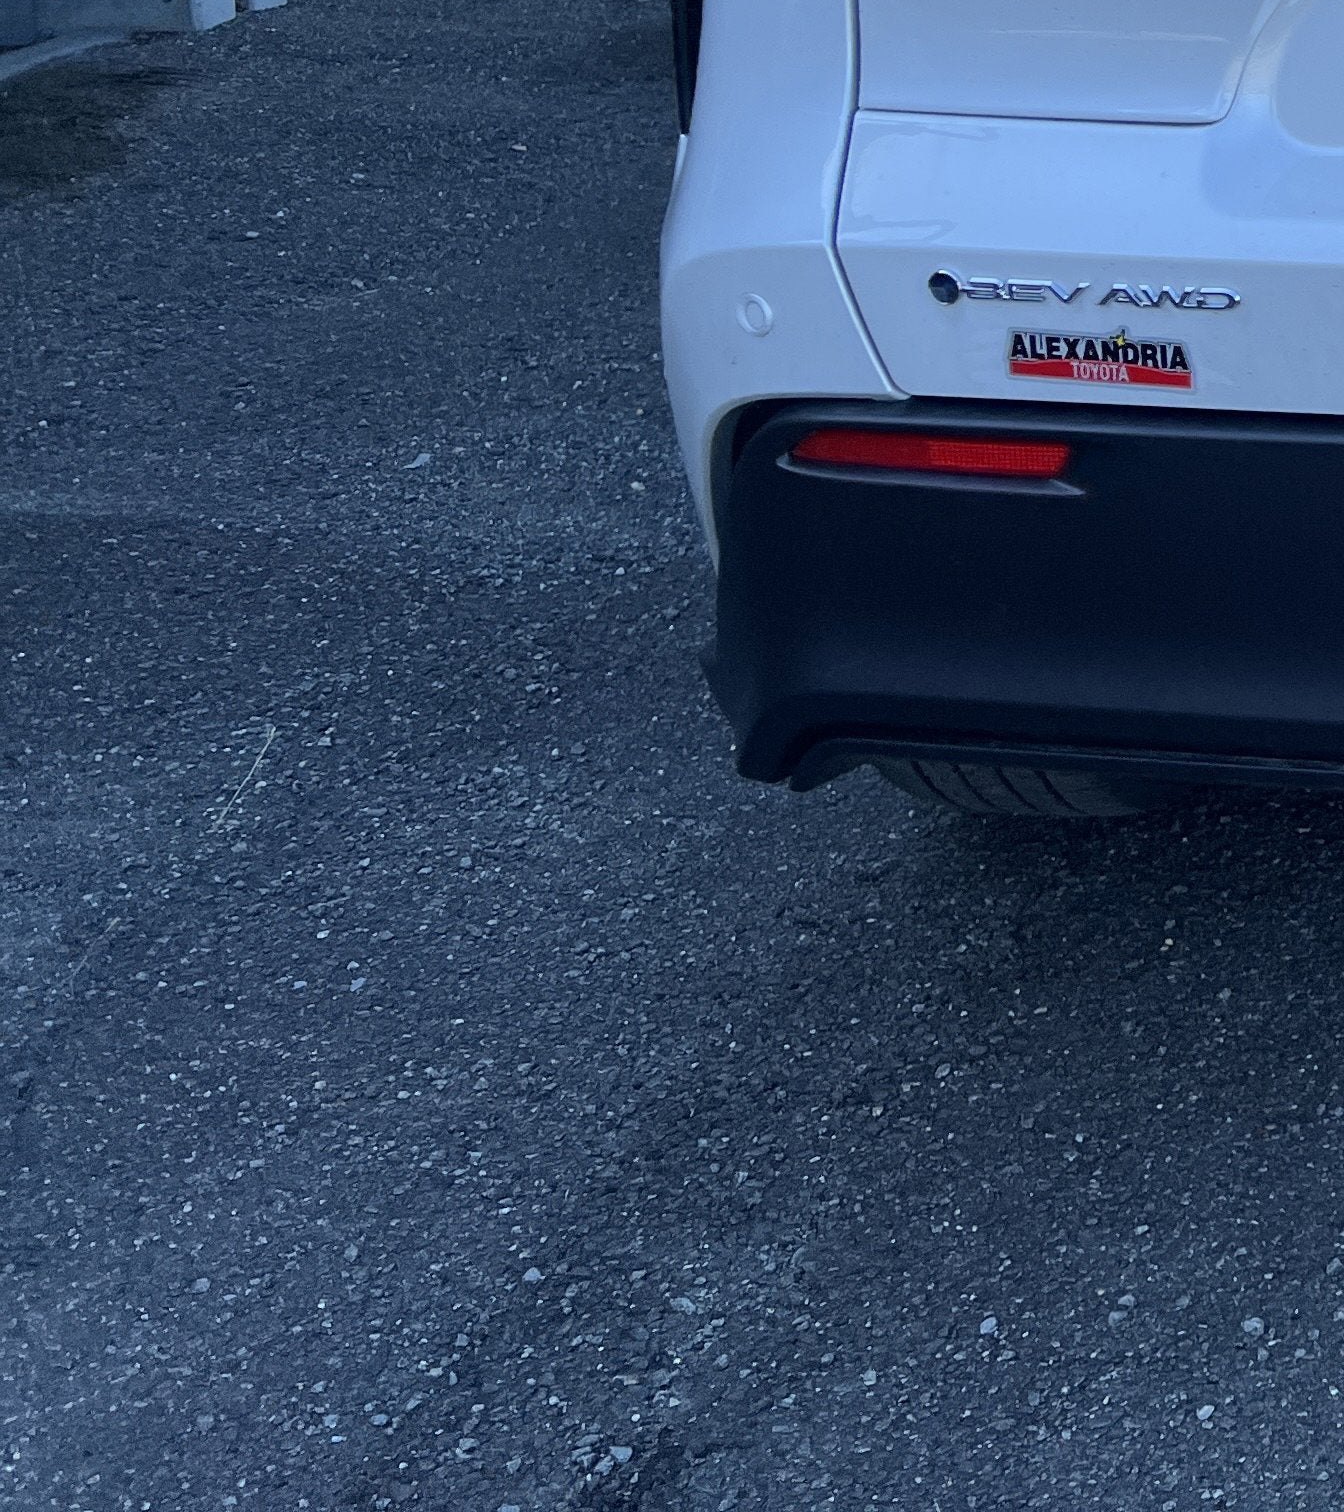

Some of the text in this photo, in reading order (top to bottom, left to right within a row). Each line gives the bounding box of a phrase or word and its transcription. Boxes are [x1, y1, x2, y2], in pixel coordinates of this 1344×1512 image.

[1096, 283, 1241, 310] AWD
[1010, 333, 1190, 371] ALEXANDRIA
[1071, 361, 1130, 383] TOYOTA
